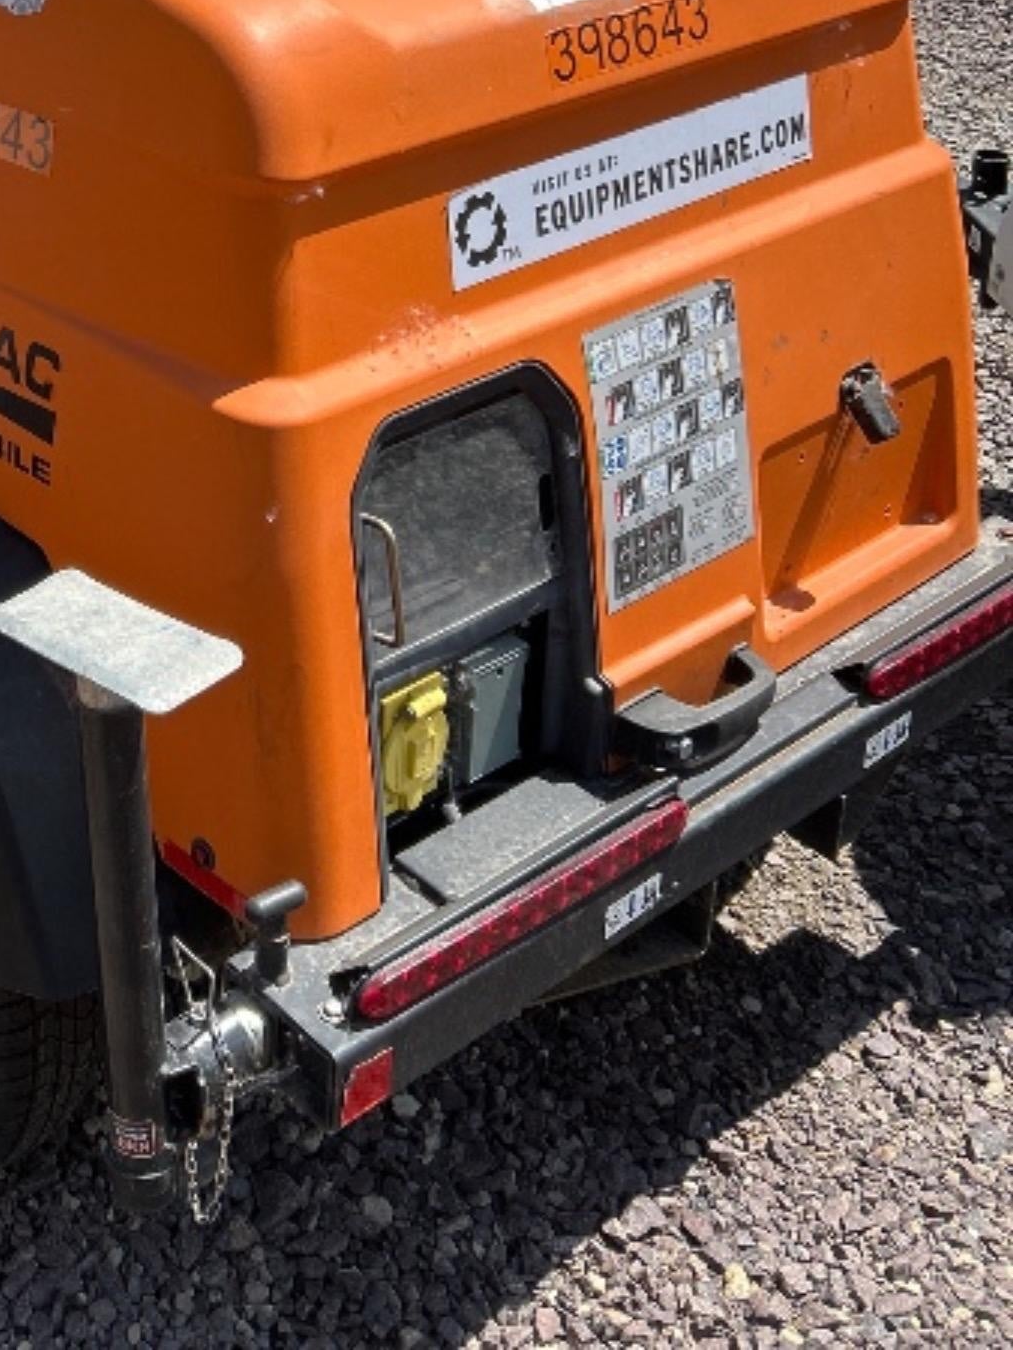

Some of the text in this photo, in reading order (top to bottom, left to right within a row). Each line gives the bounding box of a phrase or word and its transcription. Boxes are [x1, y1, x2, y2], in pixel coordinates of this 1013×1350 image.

[532, 170, 569, 196] VISIT
[598, 154, 619, 175] AT:
[535, 112, 806, 237] EQUIPMENTSHARE.COM
